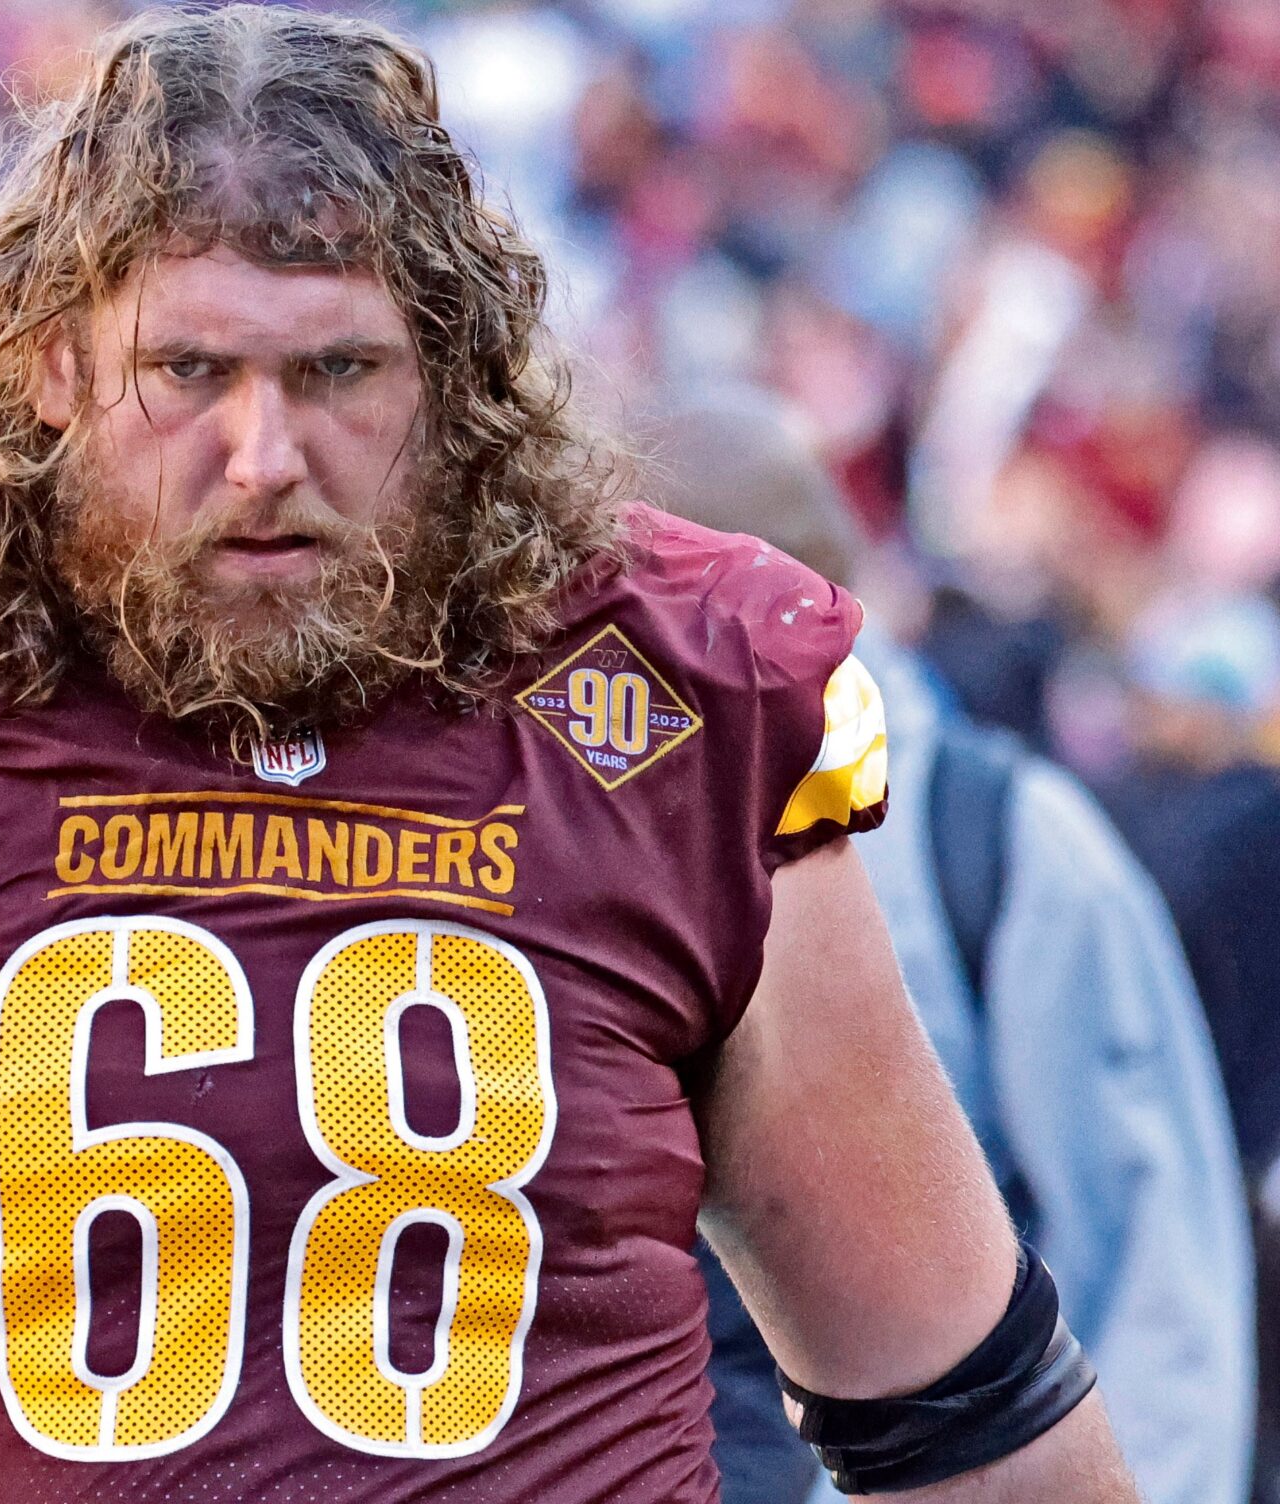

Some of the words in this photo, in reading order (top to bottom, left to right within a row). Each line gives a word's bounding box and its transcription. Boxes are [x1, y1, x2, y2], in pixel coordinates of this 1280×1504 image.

[529, 696, 566, 709] 1932
[568, 668, 650, 755] 90
[650, 713, 690, 728] 2022
[264, 741, 313, 771] NFL
[585, 750, 628, 770] YEARS
[54, 812, 518, 894] COMMANDERS
